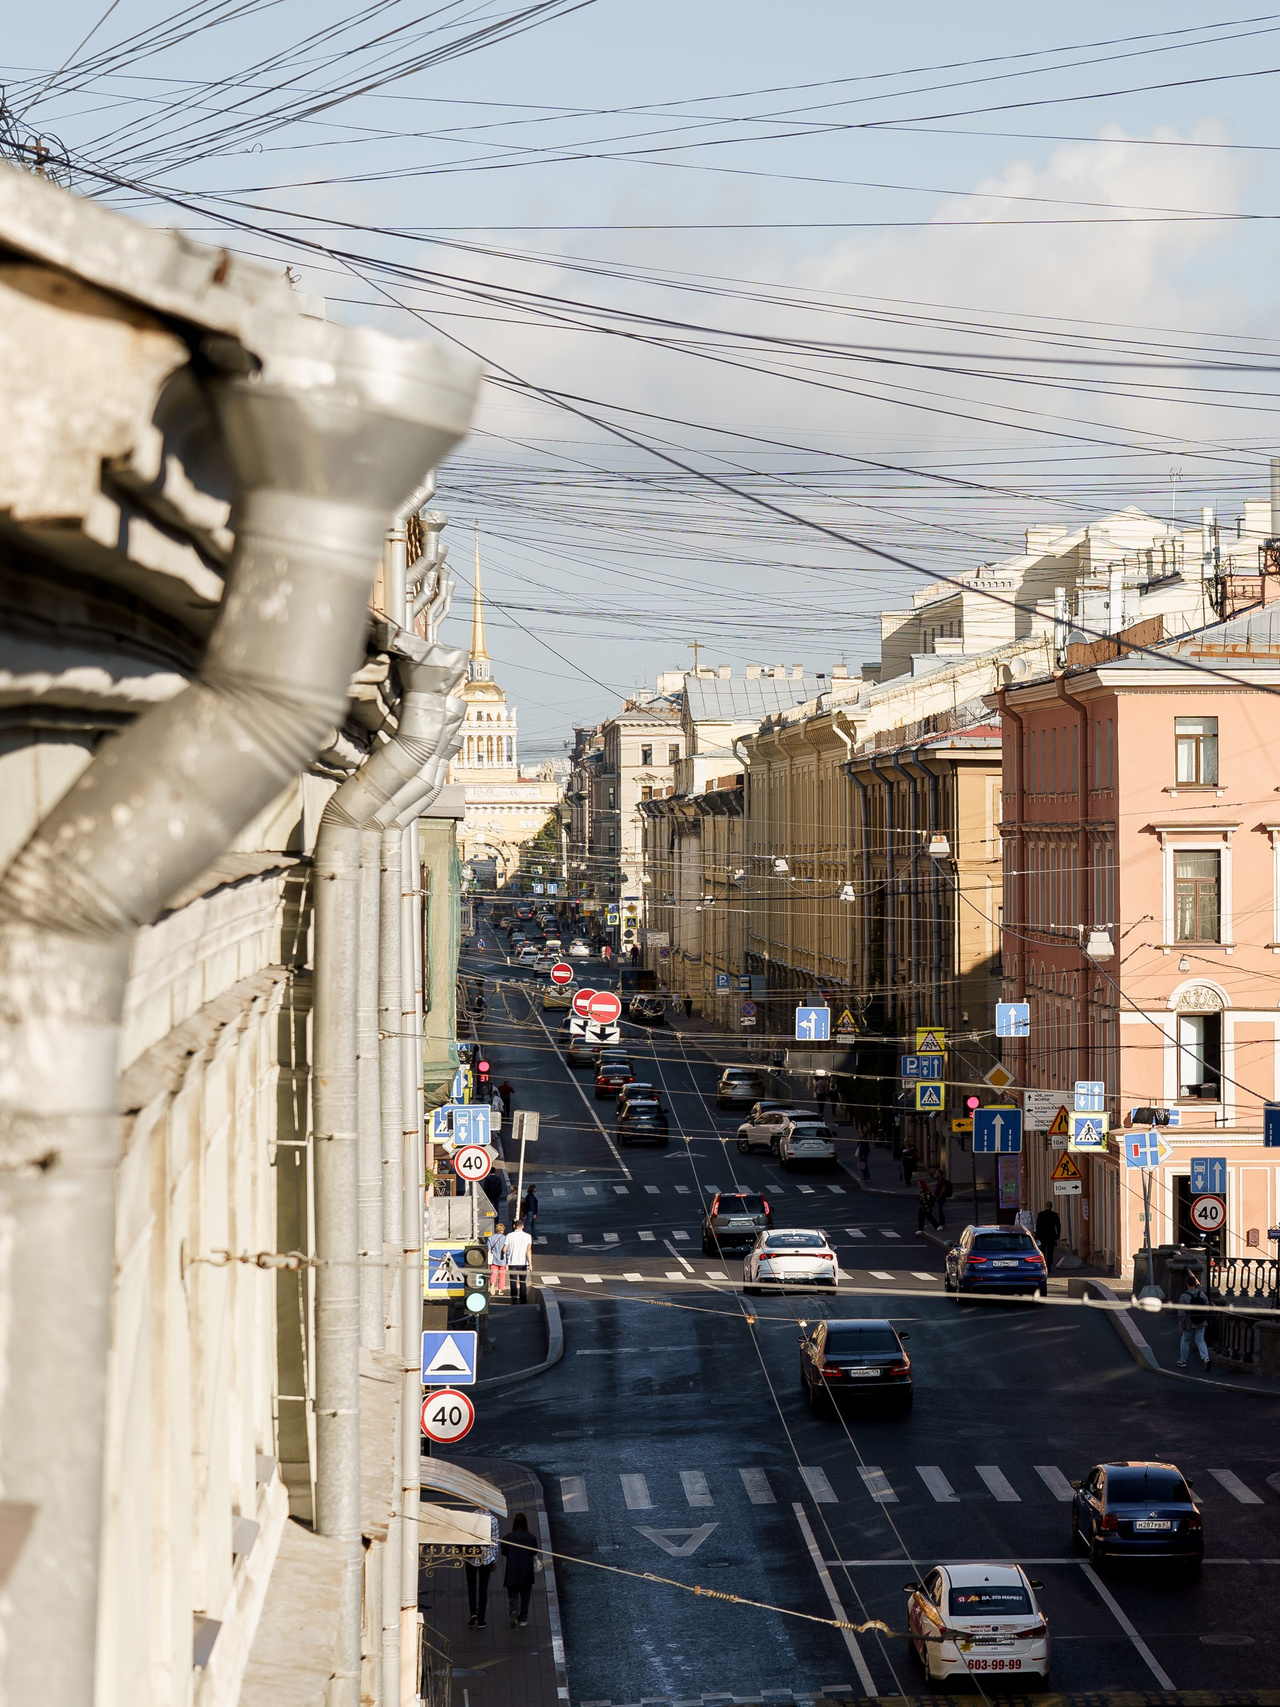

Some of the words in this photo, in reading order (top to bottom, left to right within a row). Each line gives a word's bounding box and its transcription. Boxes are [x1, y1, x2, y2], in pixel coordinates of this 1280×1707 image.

[462, 1155, 483, 1170] 40
[1198, 1206, 1219, 1220] 40
[432, 1406, 462, 1426] 40
[967, 1659, 1022, 1671] 603-99-99
